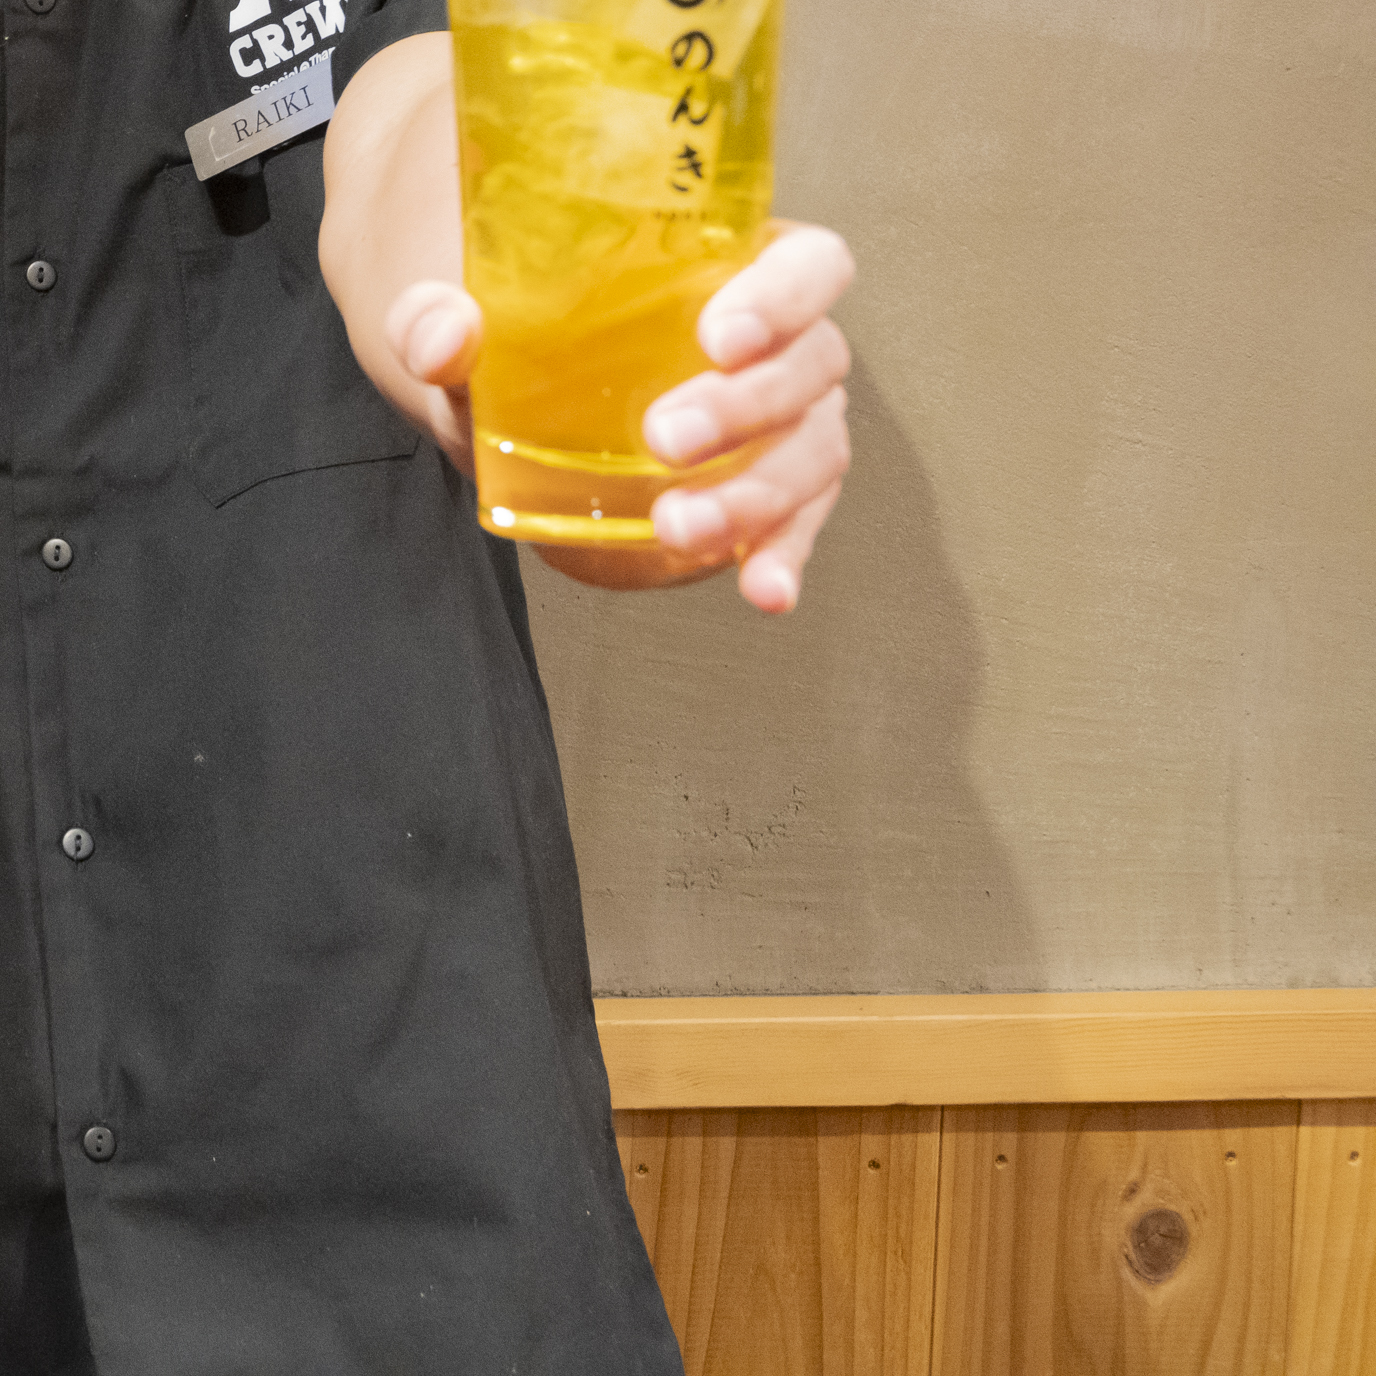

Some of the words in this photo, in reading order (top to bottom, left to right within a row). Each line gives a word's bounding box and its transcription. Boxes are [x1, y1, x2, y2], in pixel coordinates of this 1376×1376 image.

[231, 85, 314, 144] RAIKI
[670, 30, 714, 192] のんき
